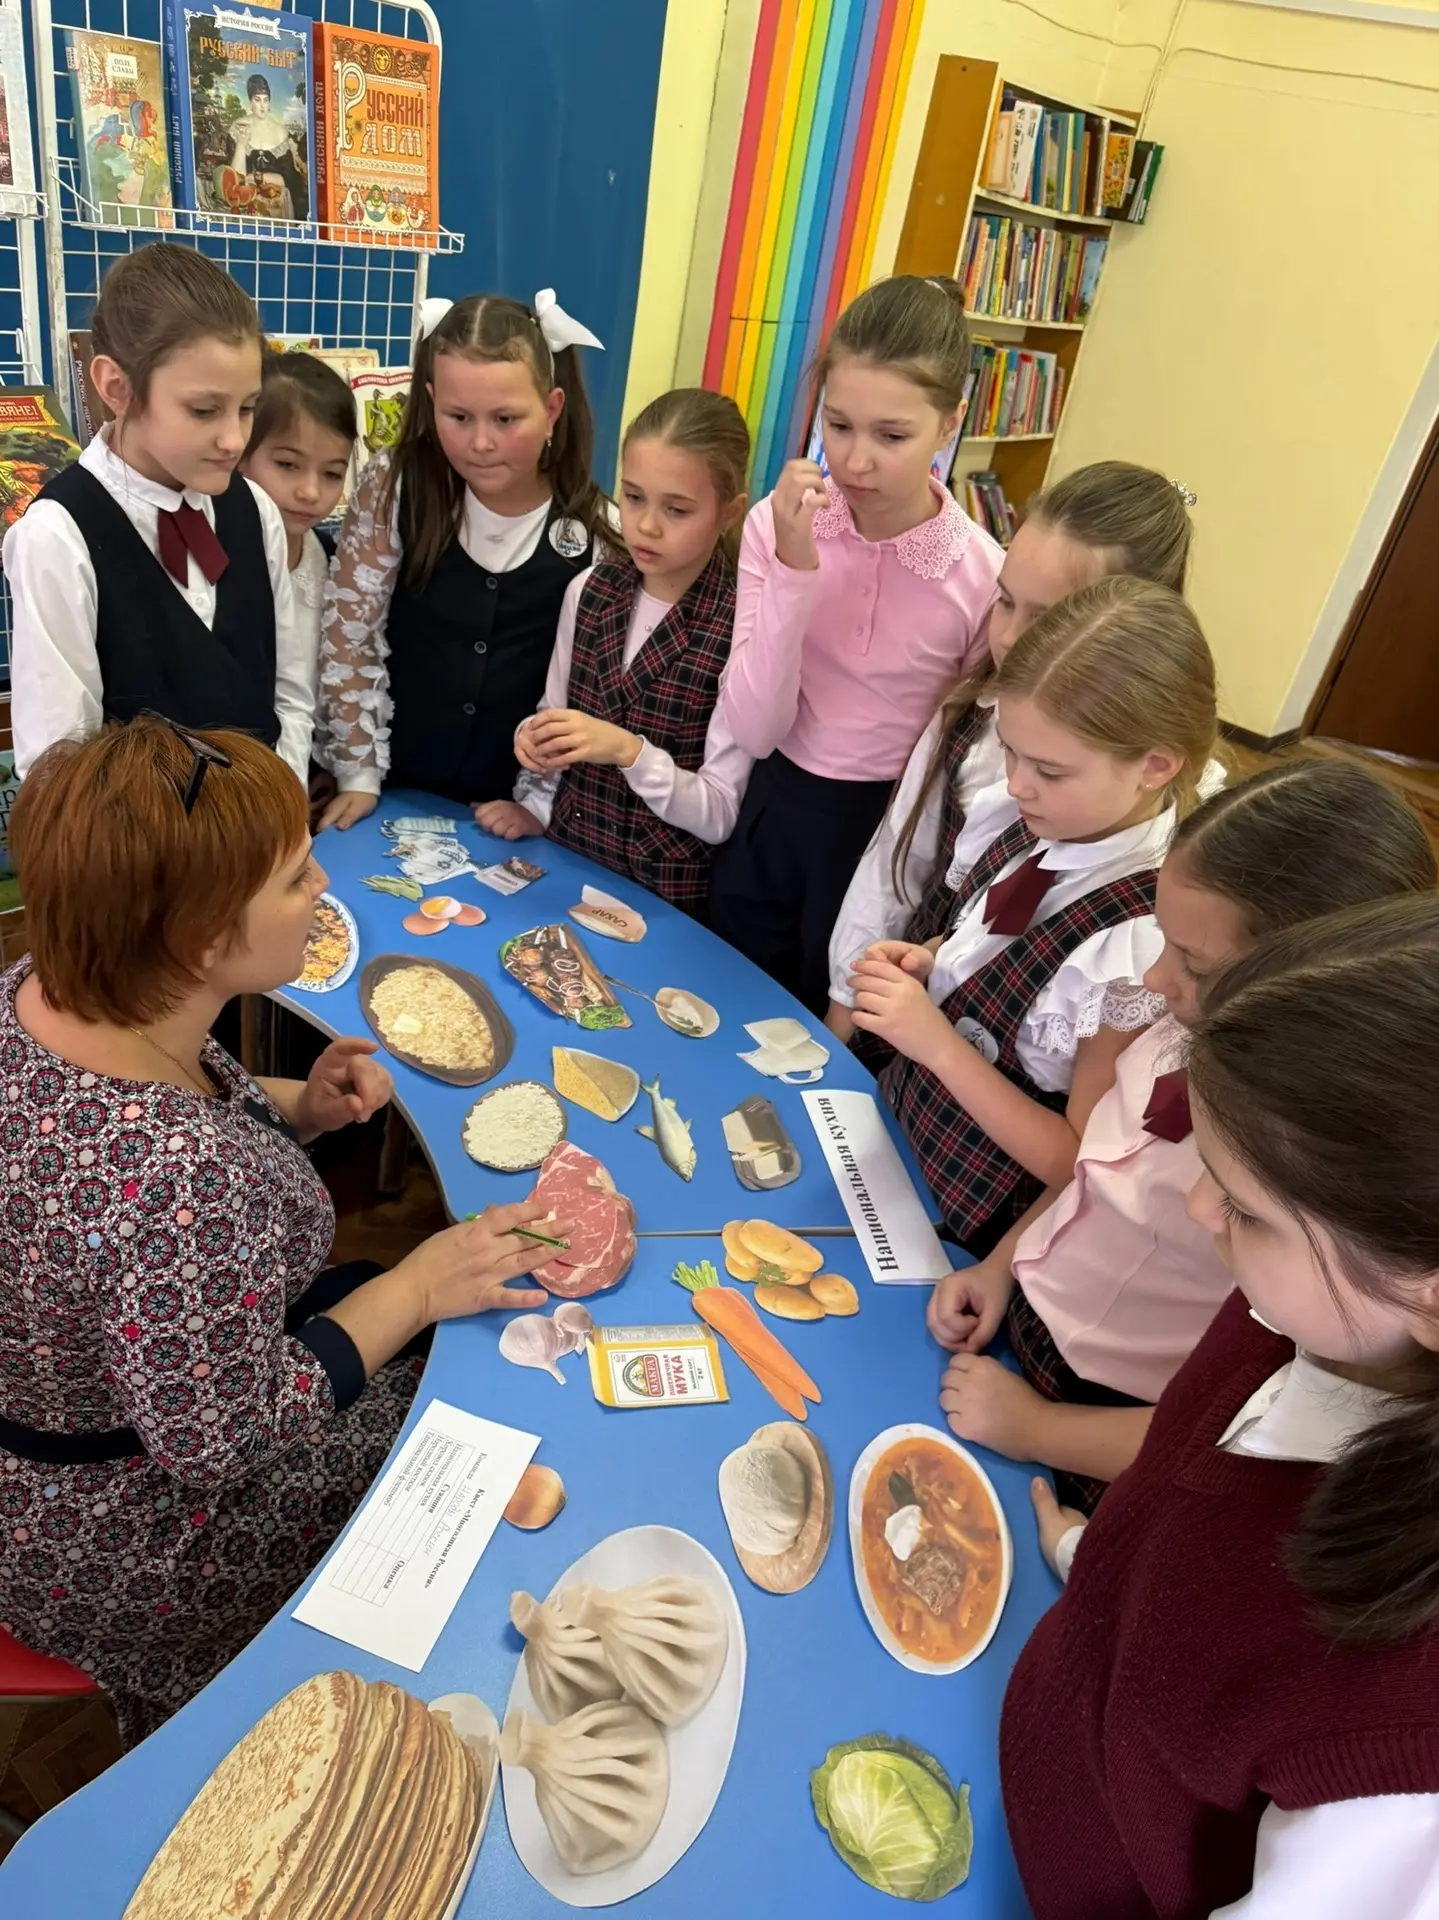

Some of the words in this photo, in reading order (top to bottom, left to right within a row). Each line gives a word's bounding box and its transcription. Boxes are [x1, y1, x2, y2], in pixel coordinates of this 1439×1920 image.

[221, 15, 250, 27] ИСТОРИЯ
[250, 20, 274, 32] РОССИИ
[114, 58, 131, 67] ПОЛЕ
[200, 36, 260, 64] РУССКИЙ
[267, 47, 296, 68] БЫТ
[112, 66, 134, 75] СЛАВЫ
[315, 81, 324, 114] ДОМ
[361, 122, 423, 158] ДОМ
[0, 405, 39, 417] ВЯНЕ!
[592, 908, 628, 928] САХАР
[817, 1097, 846, 1141] кухня
[837, 1145, 900, 1272] Национальная
[663, 1354, 675, 1396] ПШЕНИЧНАЯ
[671, 1355, 688, 1394] МУКА
[403, 1431, 435, 1475] Танцевальный
[421, 1435, 444, 1467] Народный
[432, 1440, 453, 1466] Хоровод
[432, 1443, 463, 1487] Национальная
[405, 1467, 422, 1492] костюм
[420, 1466, 435, 1487] сказок
[466, 1452, 488, 1480] Команда
[420, 1487, 434, 1507] кухня
[428, 1483, 451, 1514] Станция
[469, 1488, 485, 1509] Квест
[383, 1560, 405, 1589] Оценка
[424, 1558, 446, 1588] Россия»
